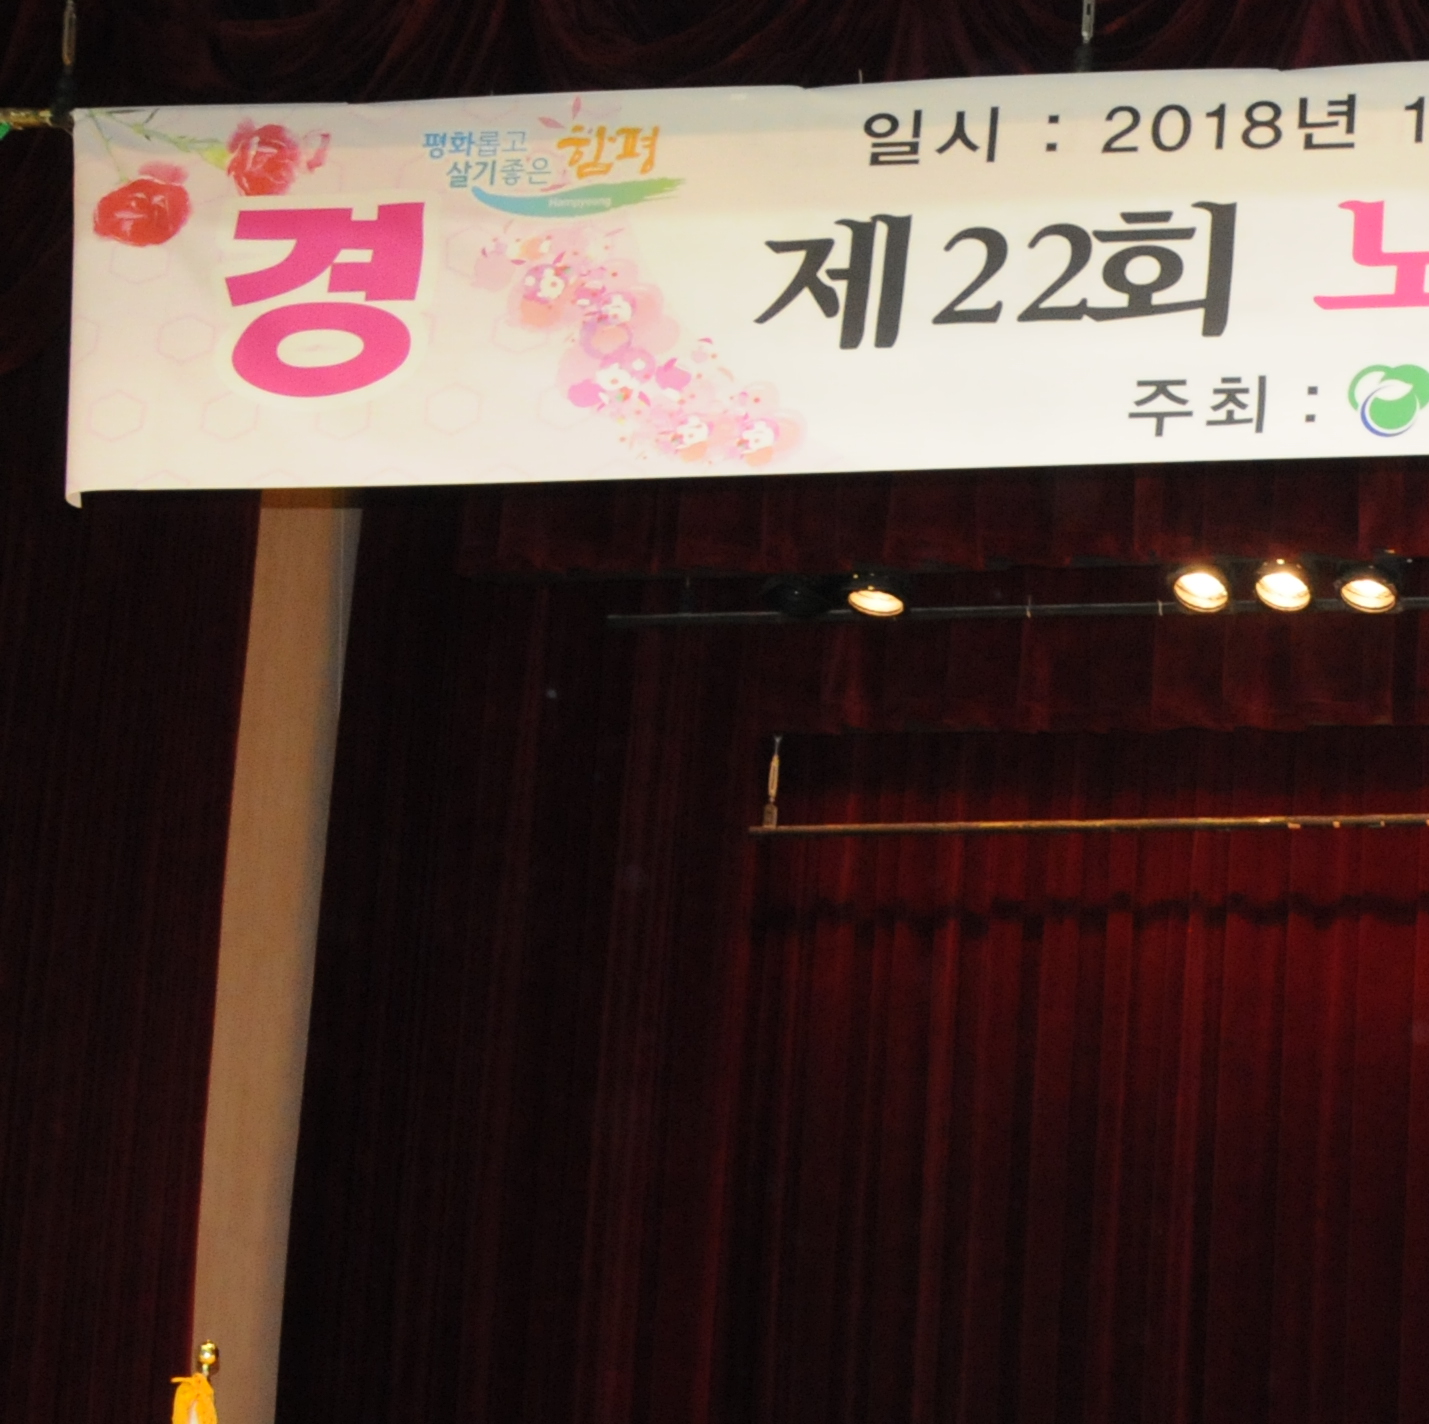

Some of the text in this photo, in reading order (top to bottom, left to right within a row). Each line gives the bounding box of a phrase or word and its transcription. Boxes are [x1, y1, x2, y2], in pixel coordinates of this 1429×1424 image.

[422, 130, 528, 159] 평화롭고
[556, 125, 659, 180] 함평
[863, 106, 1000, 166] 일시
[1102, 93, 1357, 153] 2018년
[446, 156, 552, 189] 살기좋은
[225, 201, 426, 398] 경
[754, 201, 1237, 350] 제22회
[1128, 375, 1267, 437] 주최
